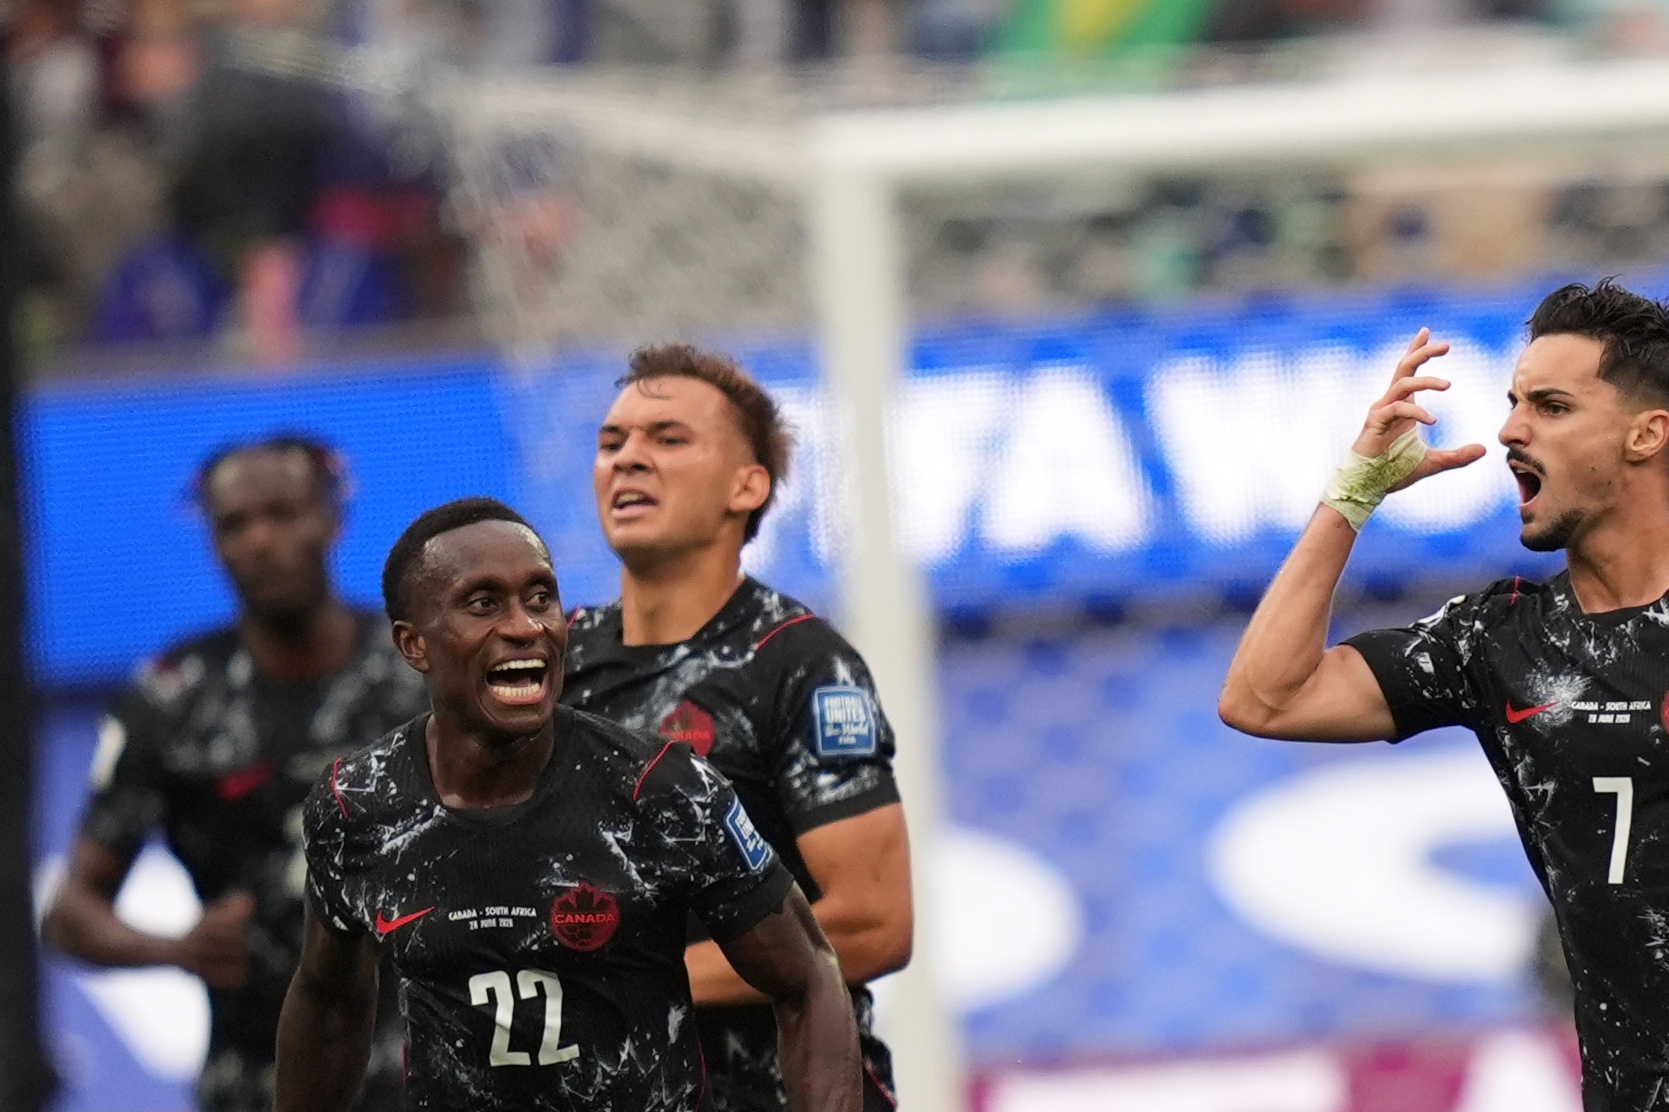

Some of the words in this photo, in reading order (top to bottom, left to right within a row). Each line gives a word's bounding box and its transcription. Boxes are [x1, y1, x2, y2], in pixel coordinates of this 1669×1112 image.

[738, 362, 1152, 573] IFA
[1571, 702, 1598, 711] CANADA
[1629, 701, 1651, 710] AFRICA
[1592, 776, 1634, 885] 7
[448, 908, 478, 922] CANADA
[485, 906, 509, 917] SOUTH
[511, 906, 537, 918] AFRICA
[554, 913, 617, 924] CANADA
[468, 969, 581, 1067] 22
